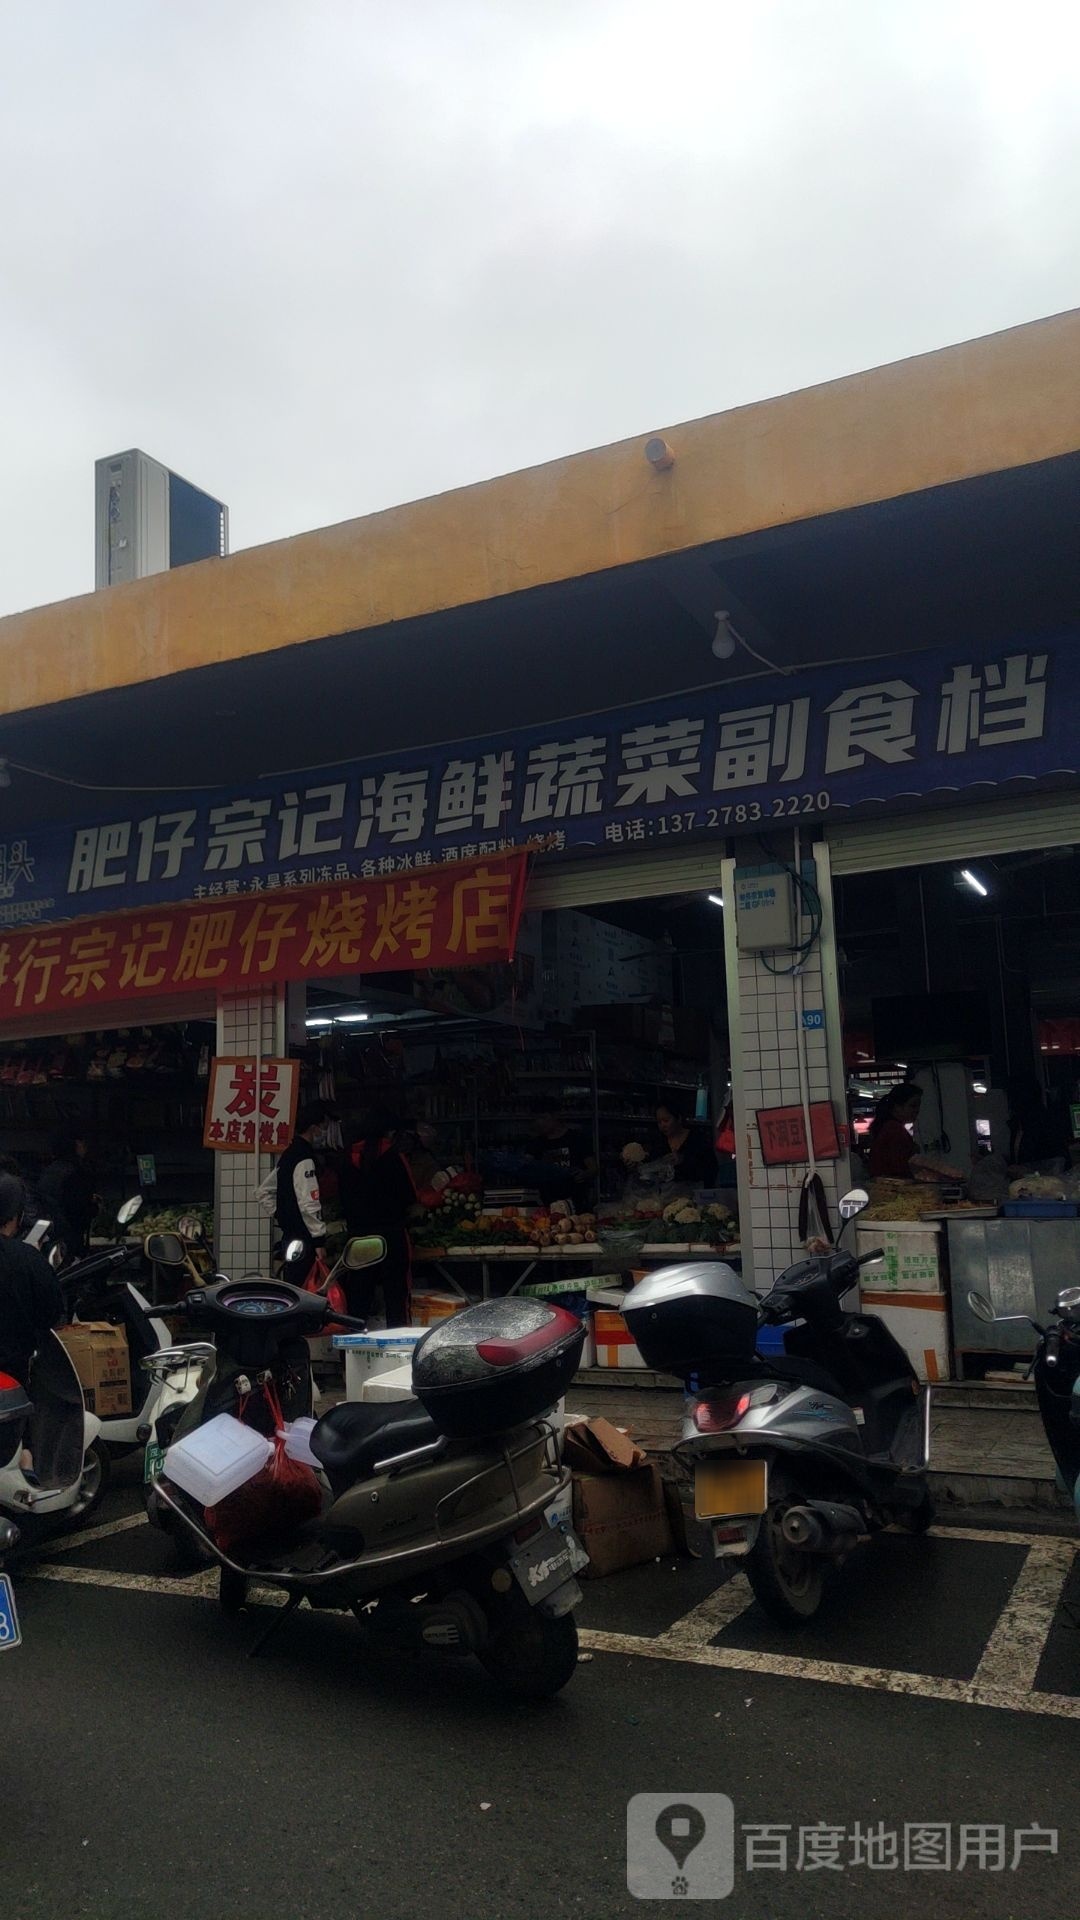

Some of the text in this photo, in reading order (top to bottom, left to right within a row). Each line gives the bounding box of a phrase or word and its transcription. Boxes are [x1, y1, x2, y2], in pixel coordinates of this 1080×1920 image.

[67, 654, 1048, 893] 肥仔宗记海鲜蔬菜副食档
[707, 802, 761, 828] 2783
[772, 791, 830, 818] 2220
[225, 1064, 280, 1118] 炭
